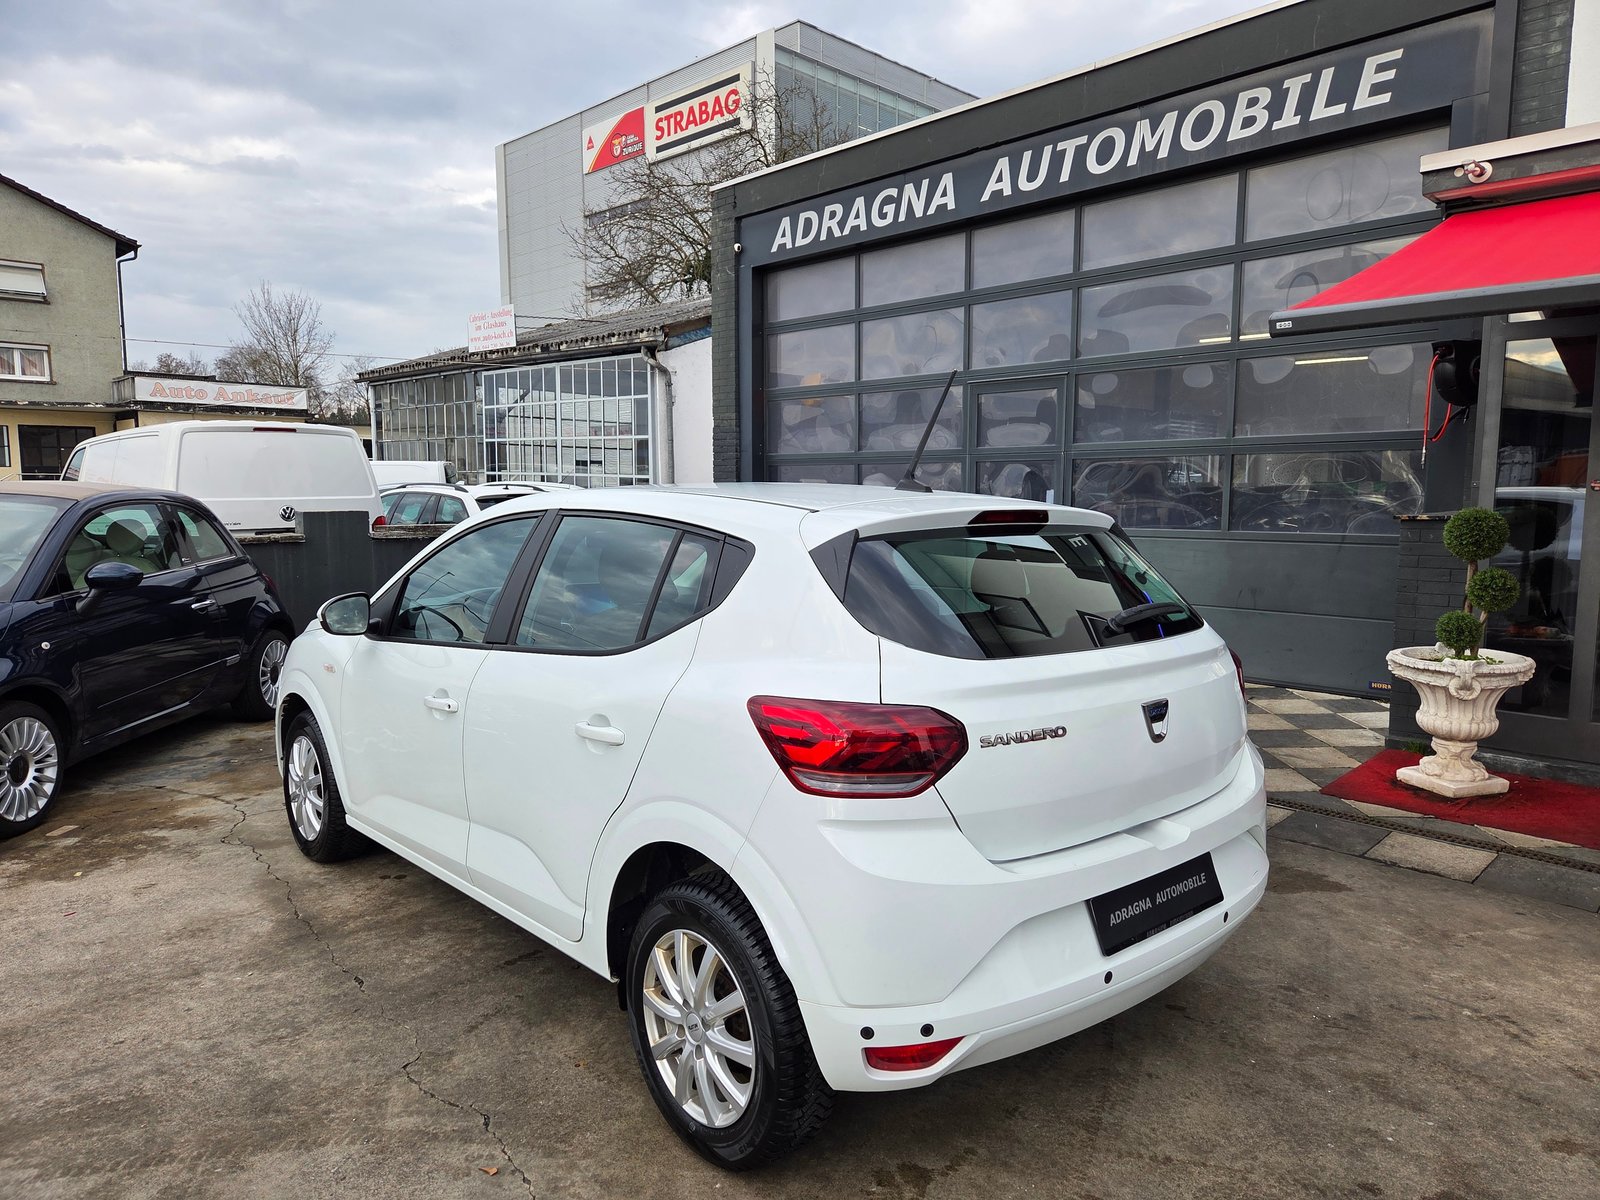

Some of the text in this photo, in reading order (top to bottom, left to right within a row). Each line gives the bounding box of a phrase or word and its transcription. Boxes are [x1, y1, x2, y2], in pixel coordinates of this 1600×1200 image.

[655, 88, 742, 141] STRABAG
[771, 48, 1404, 253] ADRAGNA AUTOMOBILE
[150, 382, 295, 406] Auto Ankauf
[979, 725, 1068, 749] SANDERO
[1109, 896, 1153, 927] ADRAGNA
[1156, 872, 1207, 905] AUTOMOBILE
